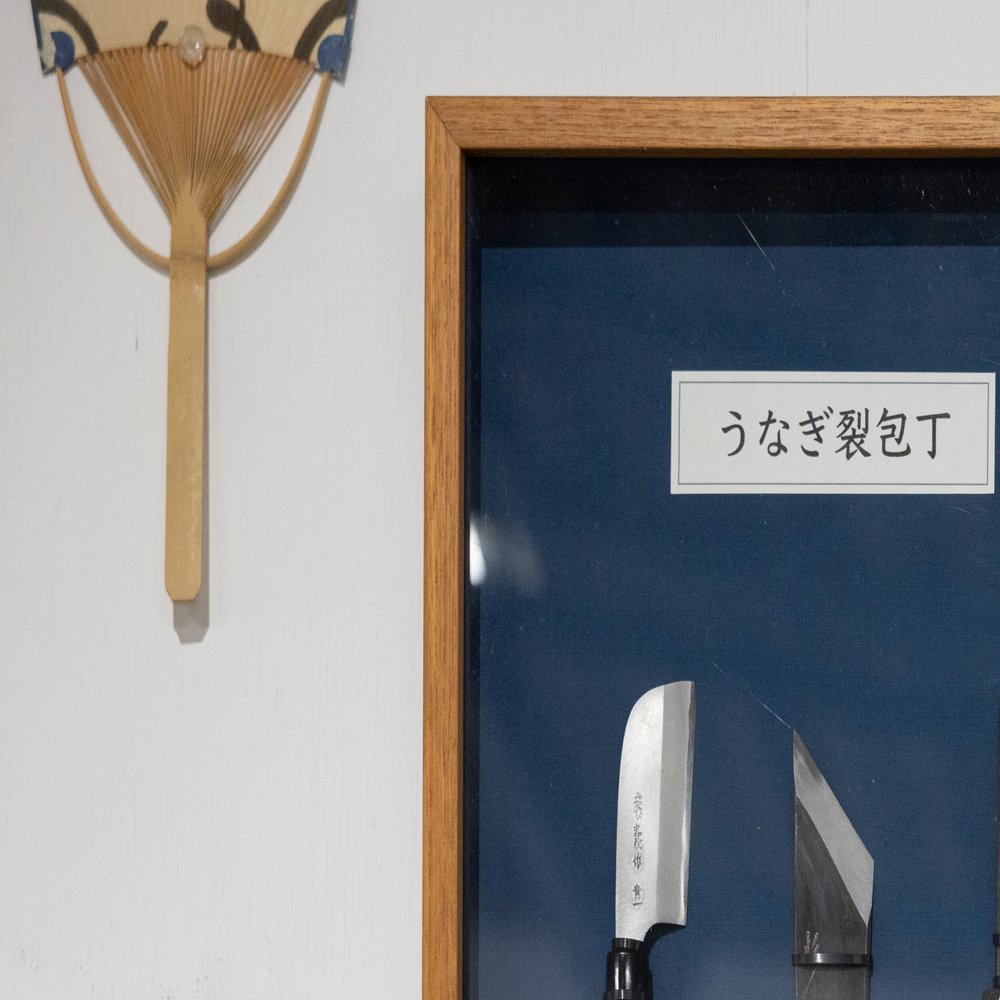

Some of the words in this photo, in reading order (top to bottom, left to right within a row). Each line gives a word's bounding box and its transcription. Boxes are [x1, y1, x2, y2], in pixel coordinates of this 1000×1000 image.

[721, 405, 952, 461] うなぎ裂包丁
